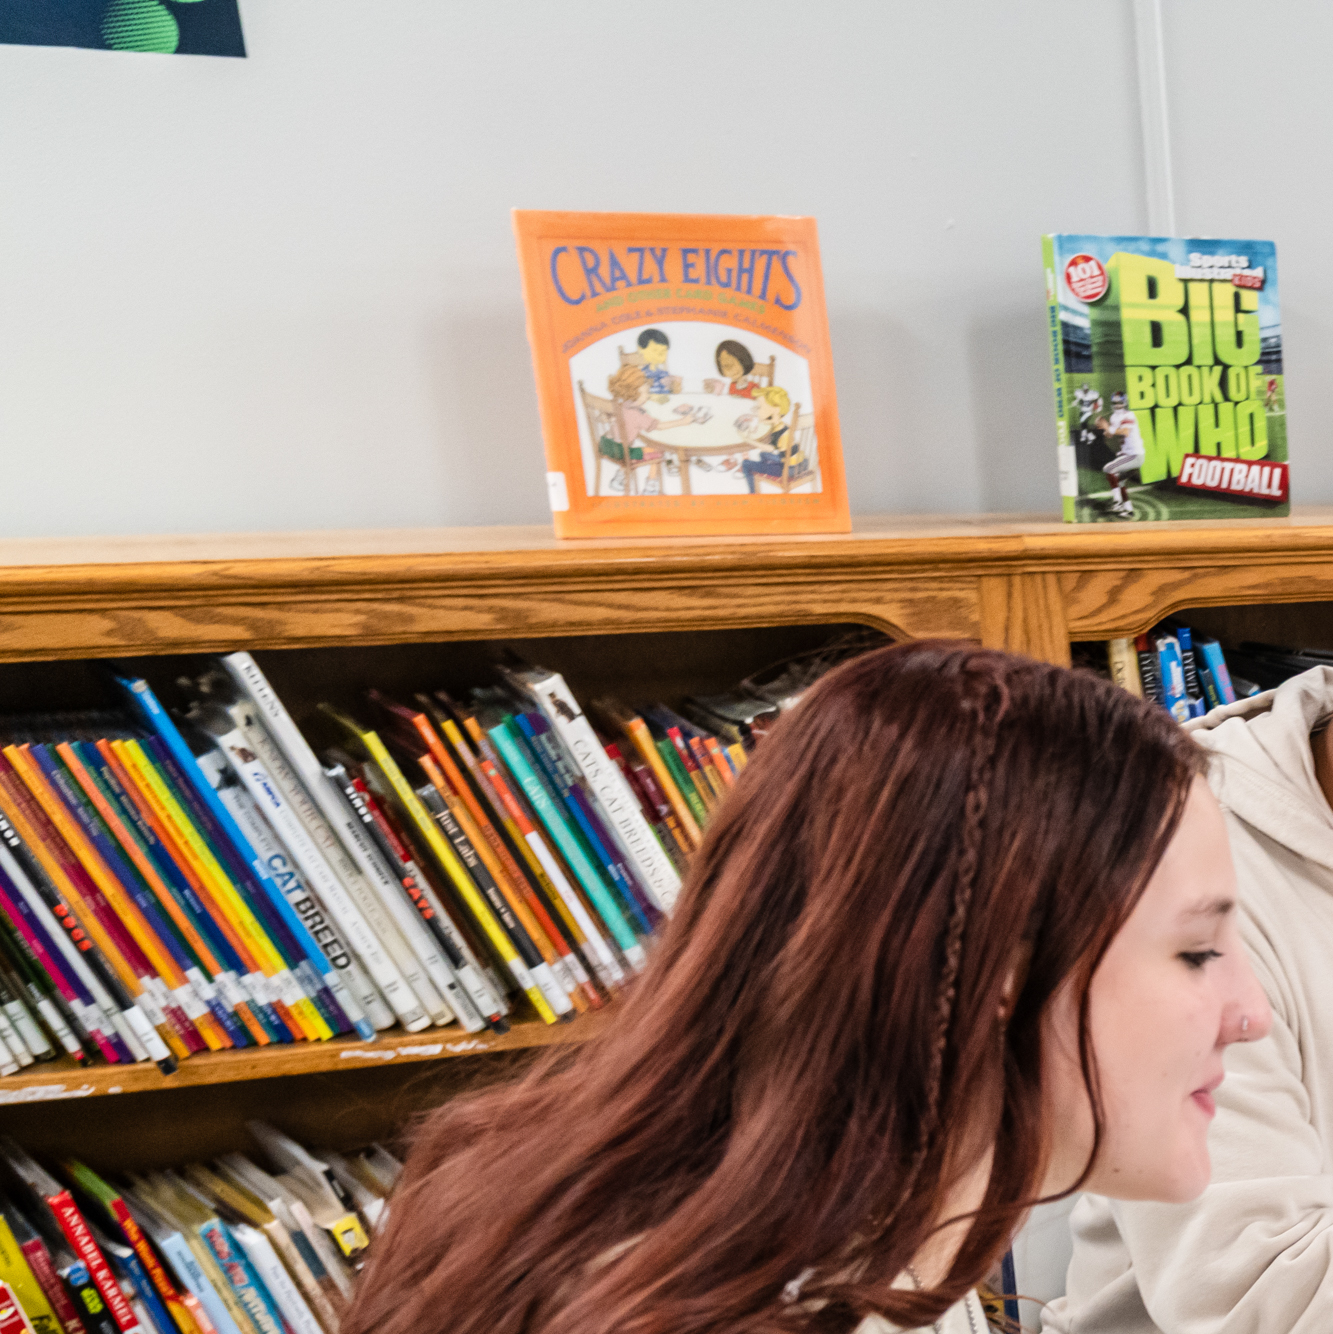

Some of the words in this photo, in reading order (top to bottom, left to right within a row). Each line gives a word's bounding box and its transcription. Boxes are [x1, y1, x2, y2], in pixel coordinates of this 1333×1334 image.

[550, 246, 669, 306] CRAZY
[679, 247, 802, 311] EIGHTS
[1068, 260, 1101, 281] 101
[1189, 252, 1249, 269] Sports
[1117, 256, 1263, 367] BIG
[1125, 365, 1224, 411] BOOK
[1227, 365, 1264, 403] OF
[1134, 400, 1269, 485] WHO
[1179, 456, 1284, 498] FOOTBALL
[240, 662, 284, 719] KITTENS
[521, 773, 552, 810] CATS
[569, 737, 606, 784] CATS,
[597, 782, 626, 815] CAT
[615, 815, 664, 880] BREEDS
[433, 807, 462, 837] Just
[451, 832, 483, 869] Labs
[263, 850, 306, 901] CAT
[292, 893, 354, 974] BREED
[120, 1216, 144, 1243] Who
[57, 1202, 106, 1270] ANNABEL
[92, 1267, 136, 1326] KARMEL
